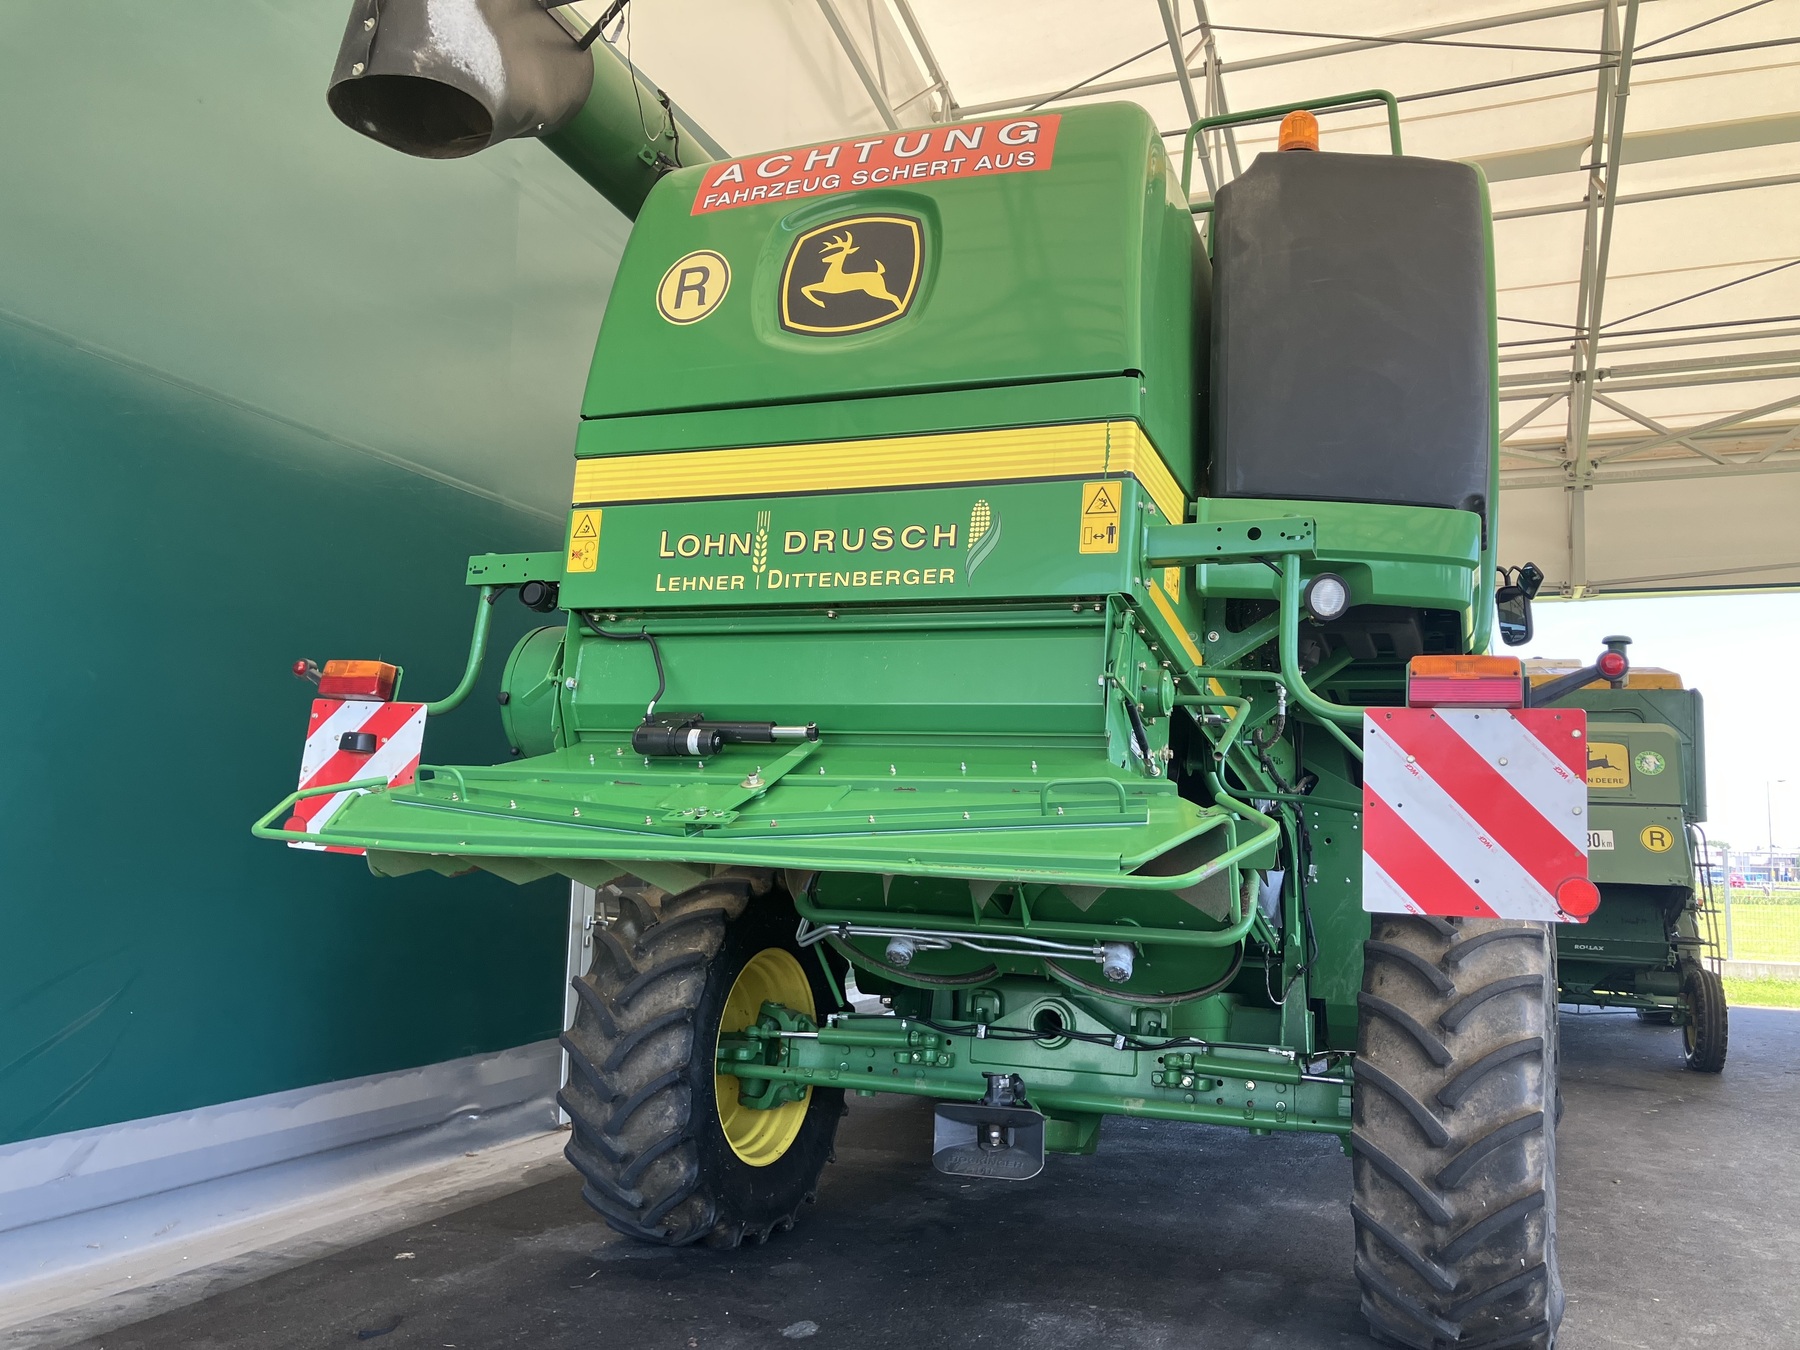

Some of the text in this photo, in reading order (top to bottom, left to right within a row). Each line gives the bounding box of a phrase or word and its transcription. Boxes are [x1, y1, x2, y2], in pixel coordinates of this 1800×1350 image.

[711, 120, 1041, 187] ACHTUNG
[702, 150, 1036, 209] FAHRZEUG SCHERT AUS
[674, 265, 706, 310] R
[658, 524, 958, 559] LOHN DRUSCH
[655, 567, 955, 593] LEHNER DITTENBERGER
[1553, 766, 1570, 780] WGF
[1477, 835, 1493, 849] WGF
[1601, 839, 1613, 848] km
[1649, 830, 1666, 847] R
